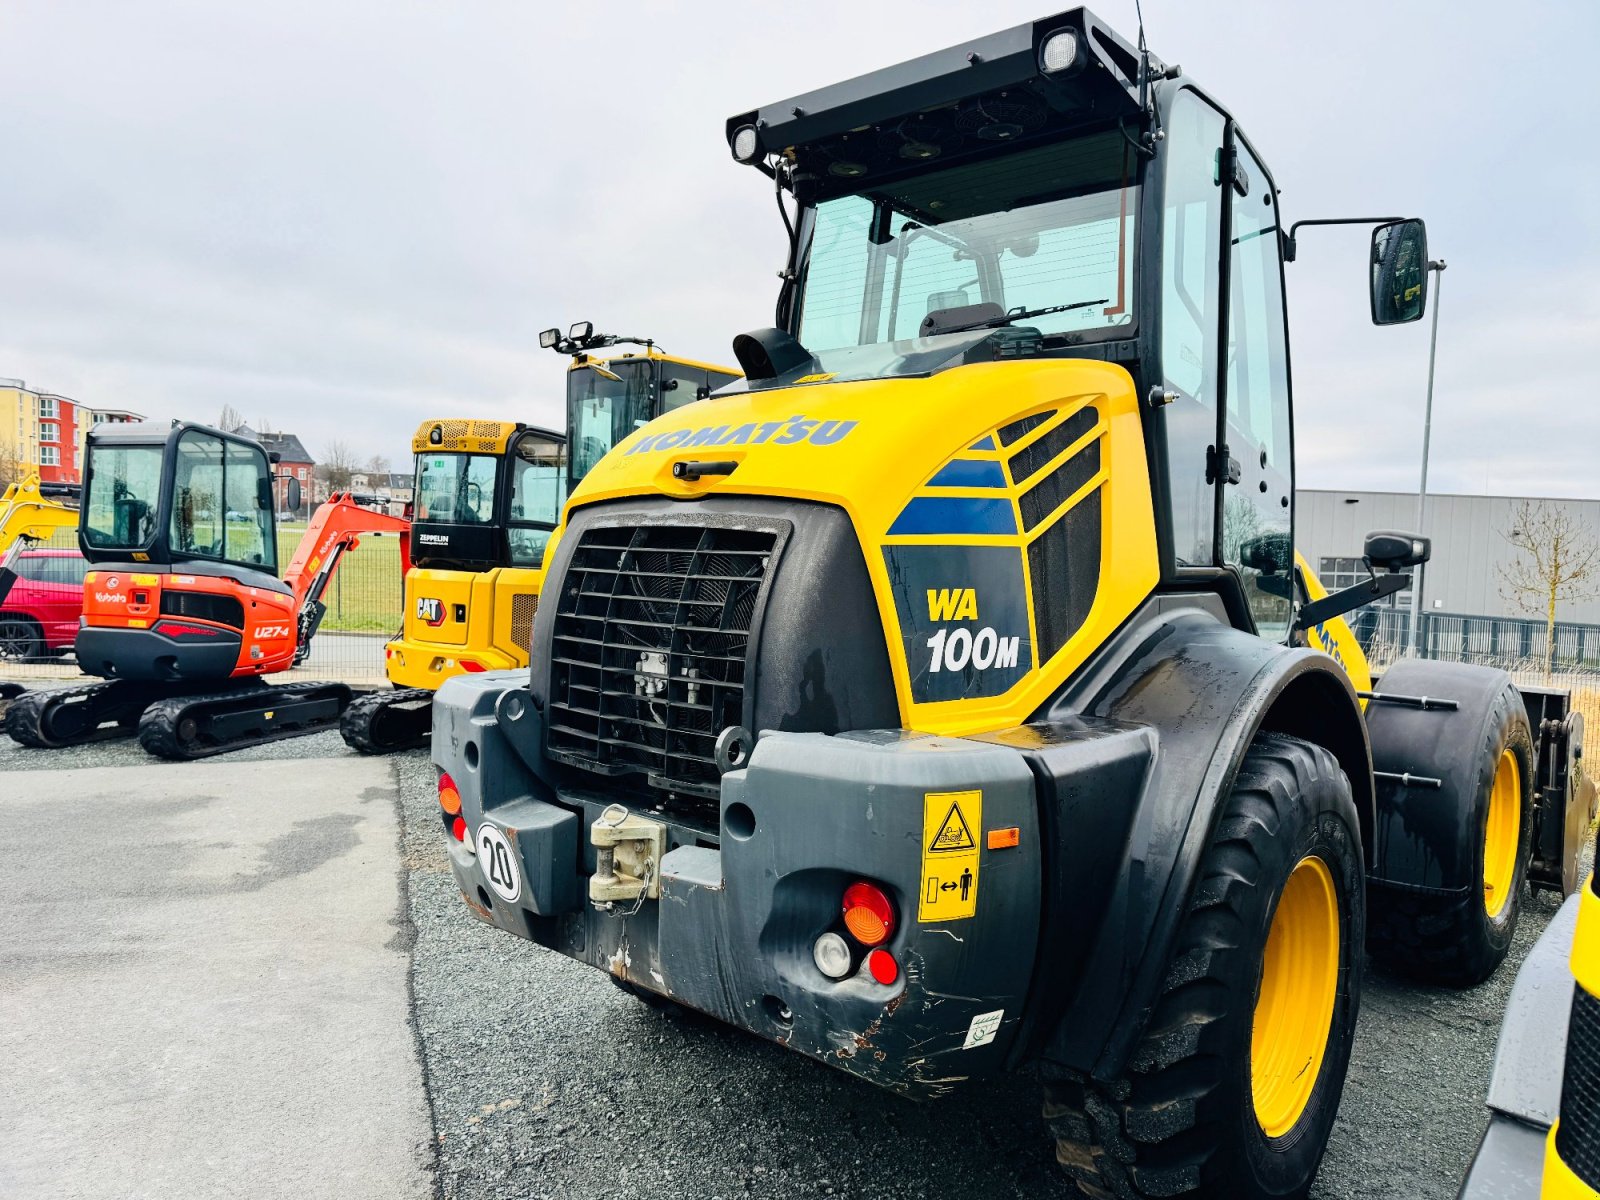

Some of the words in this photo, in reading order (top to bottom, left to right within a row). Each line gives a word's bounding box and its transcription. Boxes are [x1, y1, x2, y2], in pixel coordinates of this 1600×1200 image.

[623, 415, 860, 456] KOMATSU
[419, 534, 449, 543] ZEPPELIN
[95, 591, 127, 603] Kubota
[417, 597, 439, 621] CAT
[926, 588, 978, 622] WA
[254, 626, 289, 639] U27-4
[483, 836, 514, 890] 20
